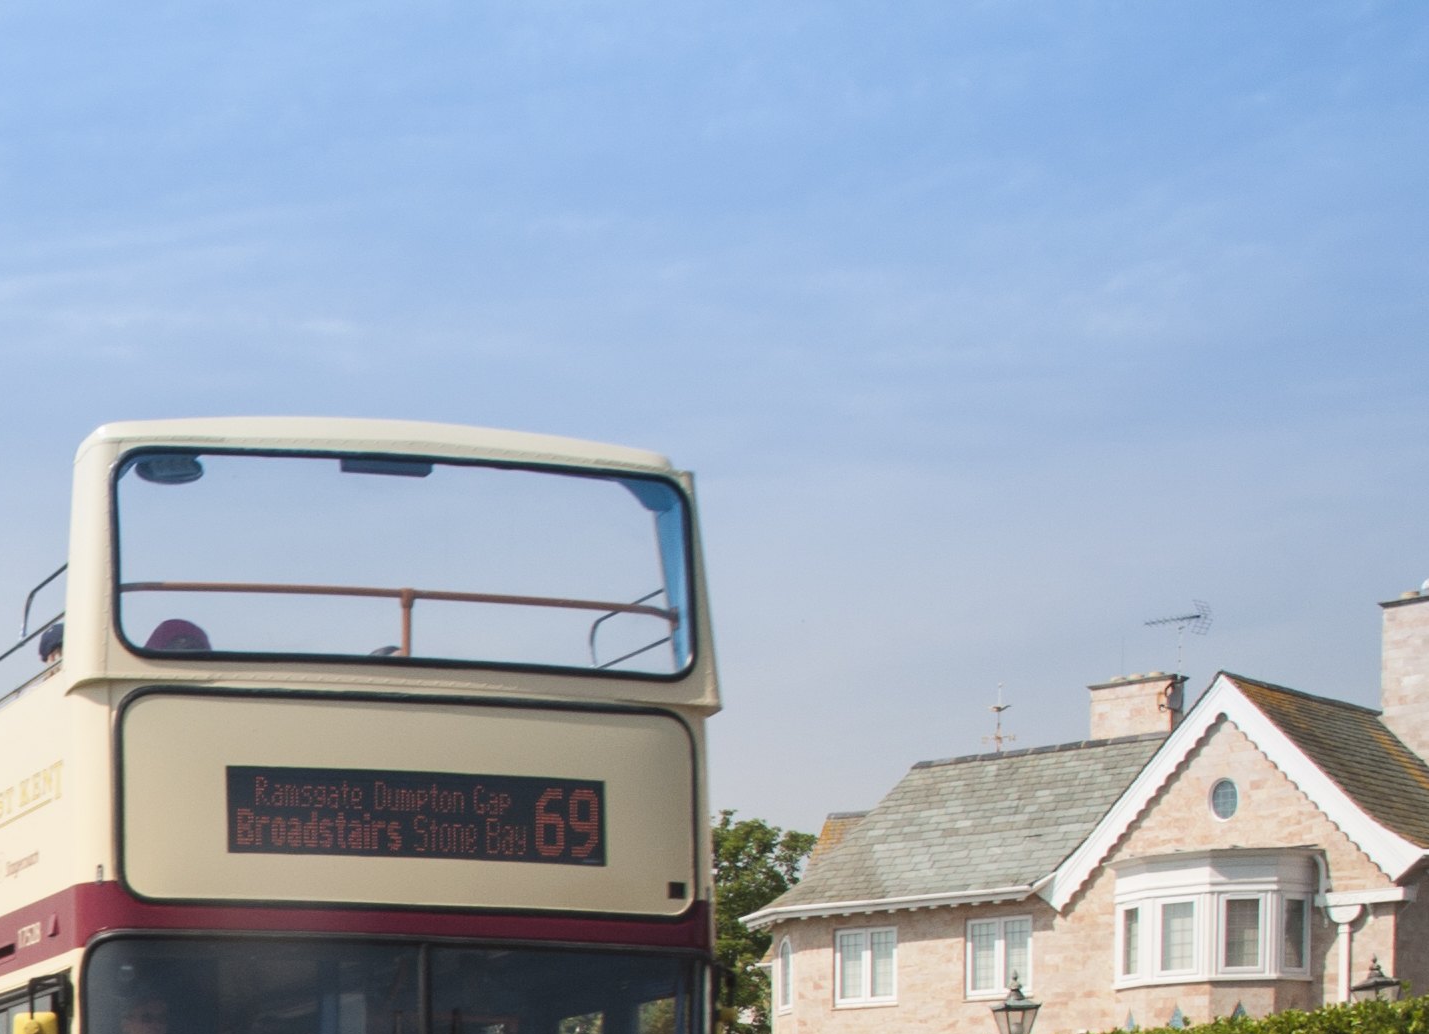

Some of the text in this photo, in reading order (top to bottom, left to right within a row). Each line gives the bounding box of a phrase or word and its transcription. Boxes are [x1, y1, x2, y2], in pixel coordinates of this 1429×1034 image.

[18, 758, 64, 808] KENT
[254, 775, 512, 816] Ramsgate Dumpton Gap
[236, 807, 528, 856] Broadstairs Stone Bay
[534, 787, 600, 858] 69
